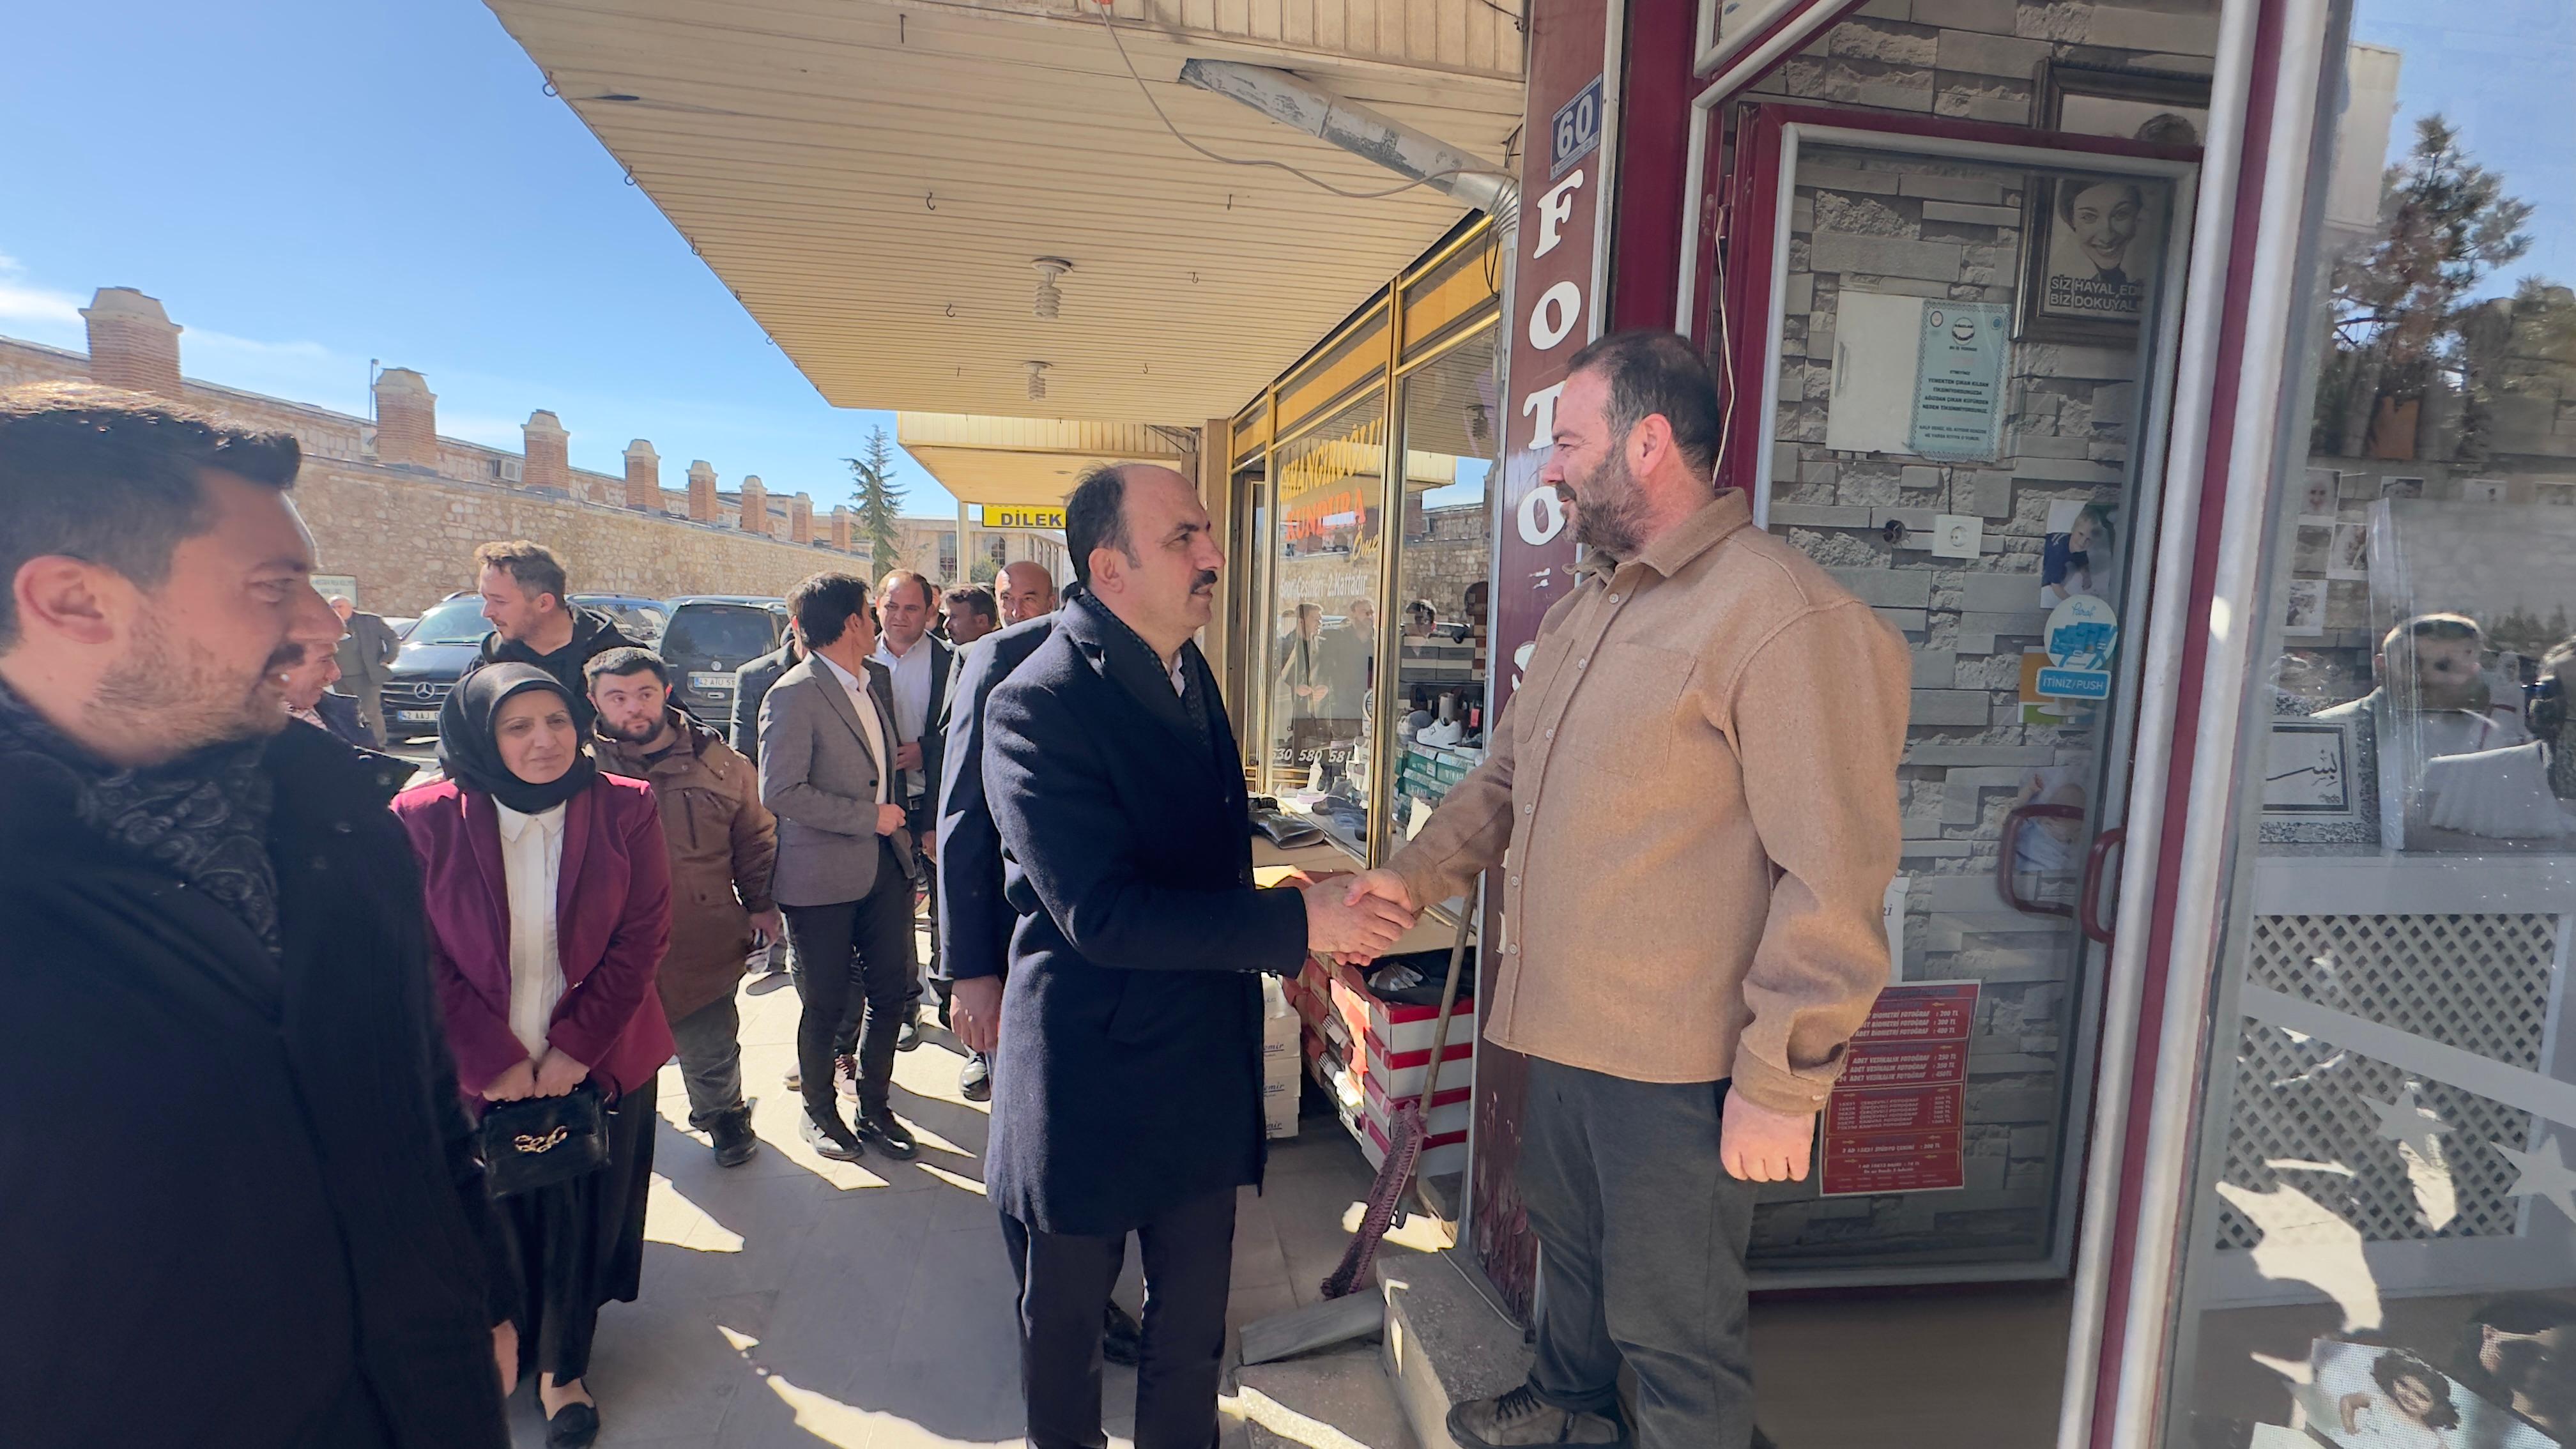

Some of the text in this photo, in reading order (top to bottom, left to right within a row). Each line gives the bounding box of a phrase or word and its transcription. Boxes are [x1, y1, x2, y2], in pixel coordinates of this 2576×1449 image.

[1557, 94, 1593, 159] 60
[2051, 276, 2071, 291] SİZ
[2050, 292, 2071, 305] BİZ
[1000, 510, 1062, 527] DİLEK
[1351, 524, 1380, 562] Öme
[2043, 674, 2104, 691] İTİNİZ/PUSH
[1298, 749, 1322, 762] 580
